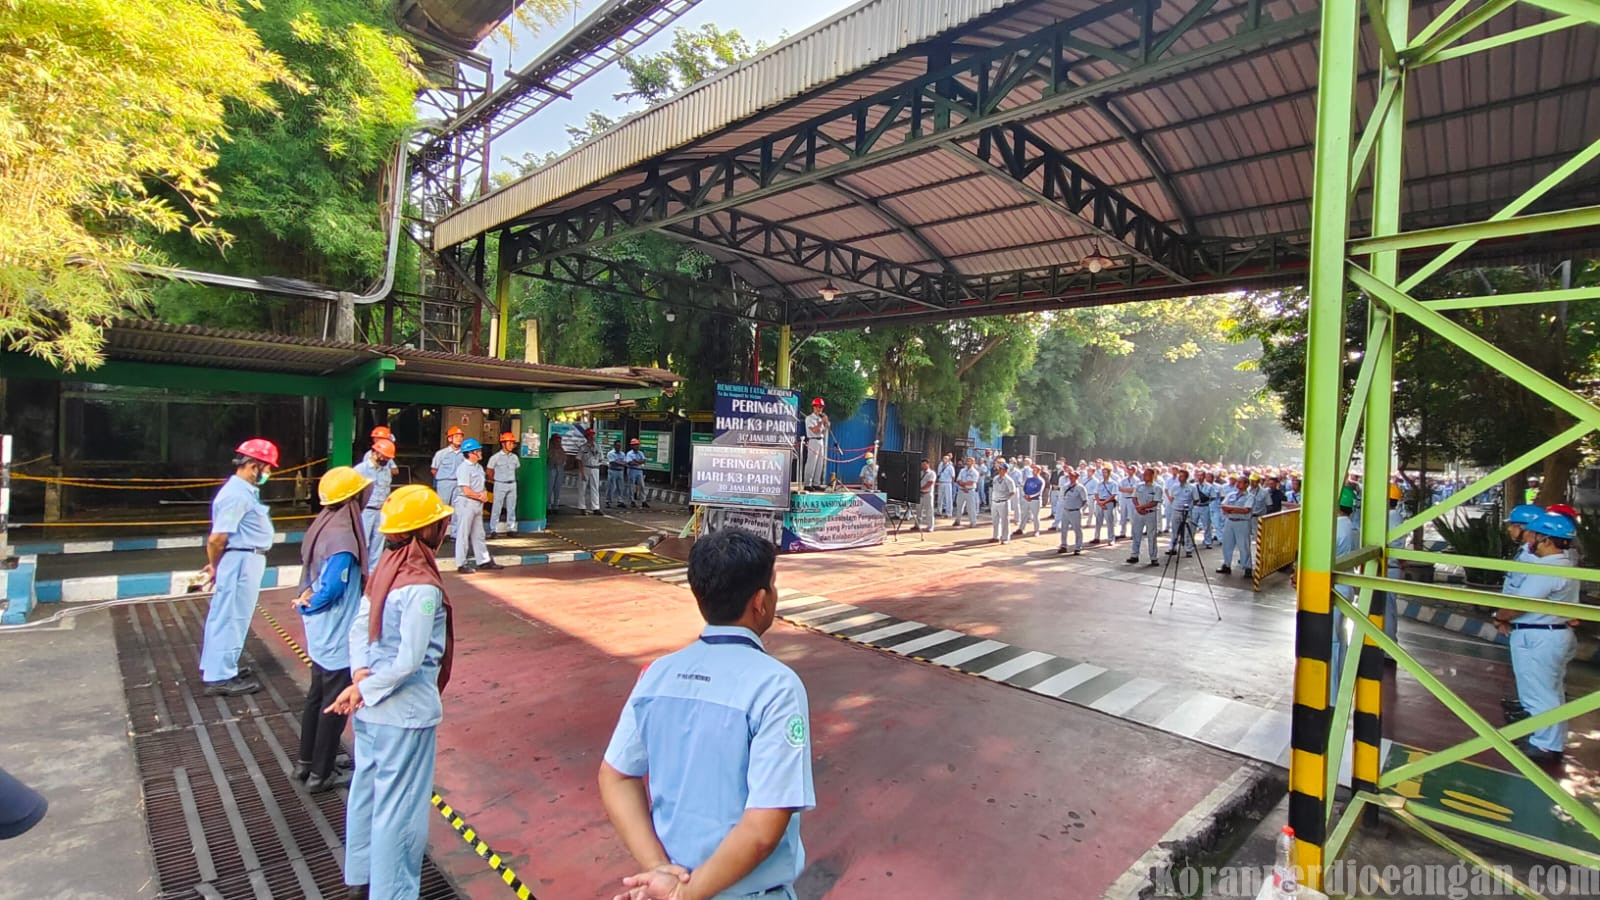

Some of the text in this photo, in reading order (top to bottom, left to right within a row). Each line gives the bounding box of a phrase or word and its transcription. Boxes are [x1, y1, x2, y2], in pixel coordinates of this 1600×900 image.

[732, 399, 796, 417] PERINGATAN
[716, 416, 796, 433] HARI K3 PARIN
[749, 434, 777, 443] JANUARI
[712, 457, 782, 471] PERINGATAN
[697, 471, 782, 485] HARI K3 PARIN
[729, 484, 760, 493] JANUARI
[826, 525, 841, 533] yang
